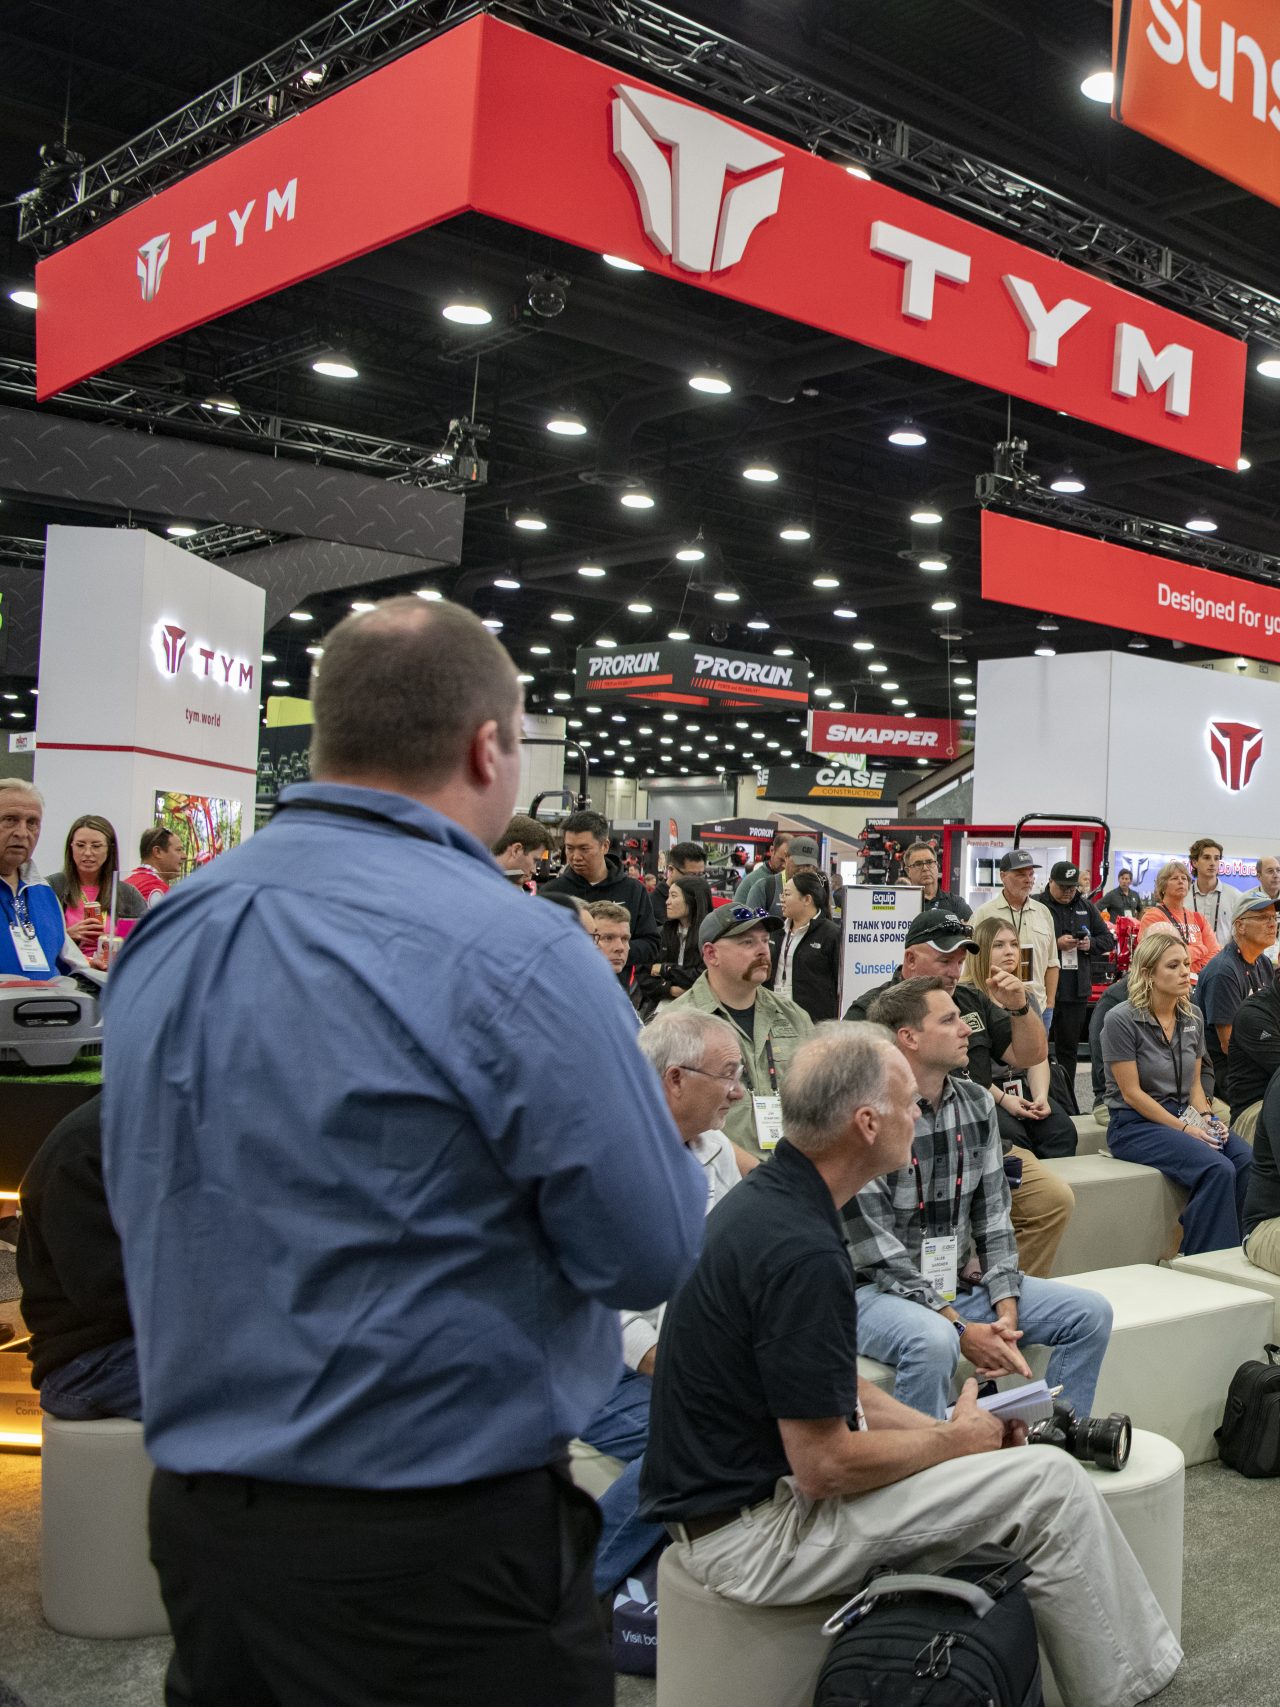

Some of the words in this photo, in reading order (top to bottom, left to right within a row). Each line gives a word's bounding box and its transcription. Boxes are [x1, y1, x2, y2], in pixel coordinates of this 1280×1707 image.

[190, 177, 298, 265] TYM
[870, 220, 1194, 417] TYM
[1158, 583, 1235, 622] Designed
[1238, 603, 1261, 628] for
[200, 647, 254, 690] TYM
[588, 651, 660, 677] PRORUN
[694, 653, 793, 687] PRORUN
[185, 708, 221, 727] tym.world
[826, 724, 938, 747] SNAPPER
[816, 768, 887, 789] CASE
[822, 788, 880, 797] CONSTRUCTION
[749, 827, 774, 838] PRORUN
[873, 892, 895, 905] equip
[853, 920, 879, 930] THANK
[881, 920, 896, 930] YOU
[848, 933, 871, 943] BEING
[873, 933, 878, 943] A
[879, 933, 905, 943] SPONS
[854, 959, 897, 975] Sunseek
[622, 1629, 643, 1645] Visit
[643, 1633, 658, 1646] bo
